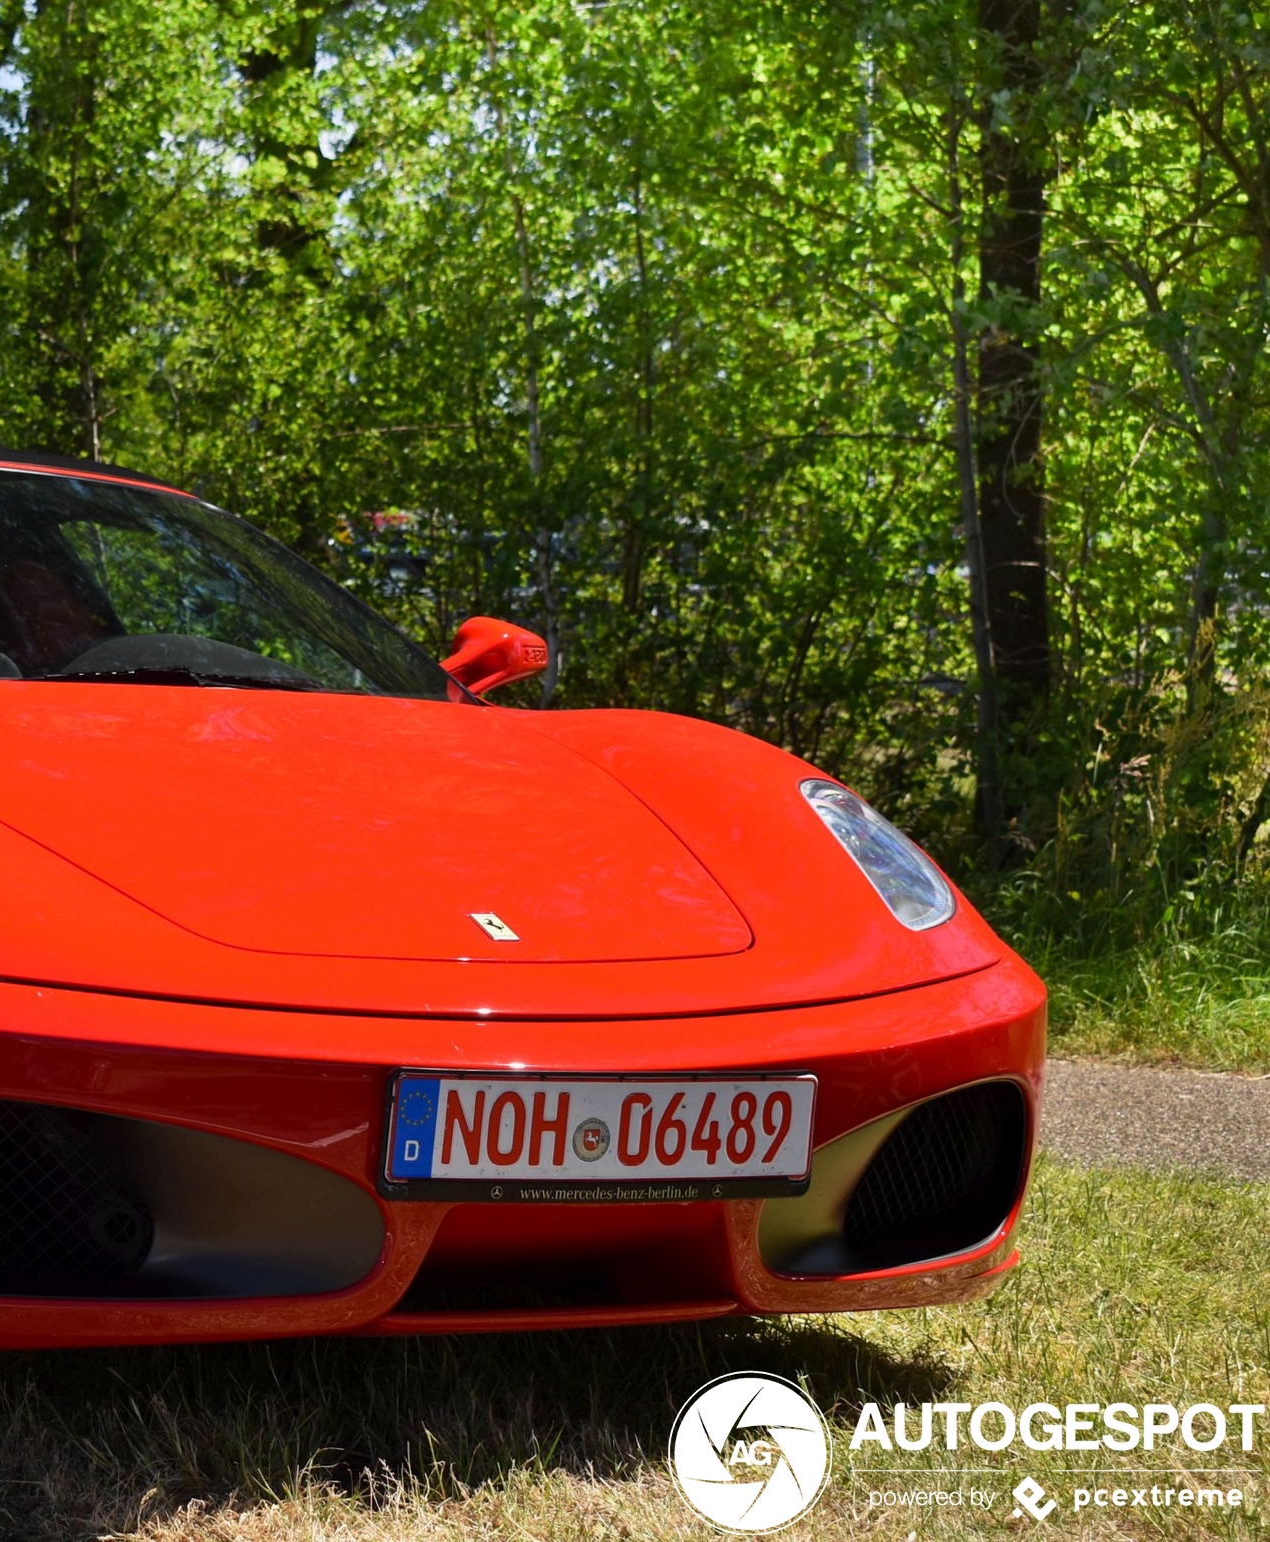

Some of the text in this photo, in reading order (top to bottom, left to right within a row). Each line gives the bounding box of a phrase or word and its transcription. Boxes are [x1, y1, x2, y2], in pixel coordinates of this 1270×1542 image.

[441, 1090, 570, 1166] NOH
[617, 1092, 792, 1167] 06489
[404, 1140, 420, 1161] D
[520, 1186, 699, 1200] www.mercedes-benz-berlin.de
